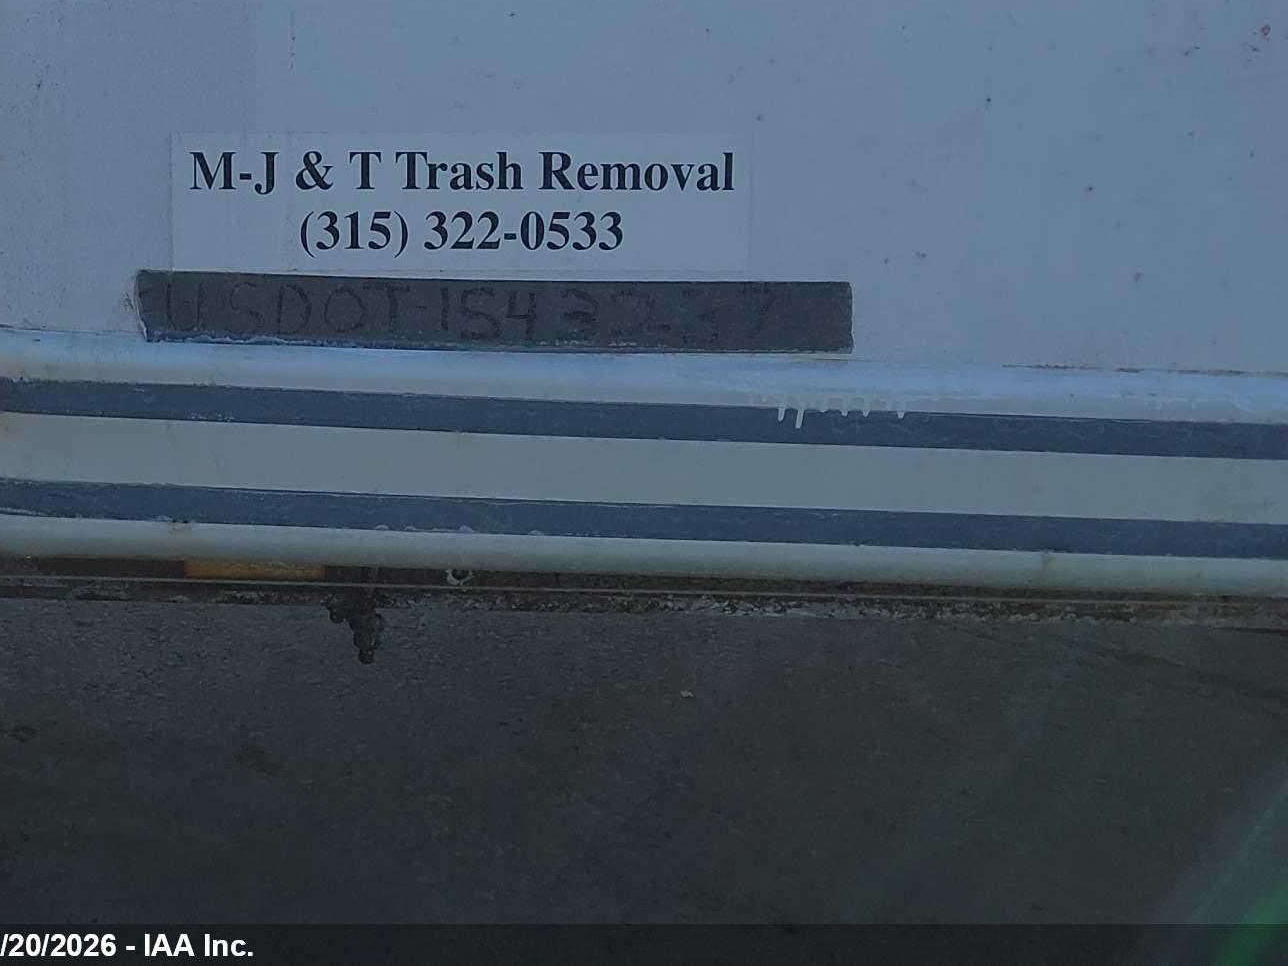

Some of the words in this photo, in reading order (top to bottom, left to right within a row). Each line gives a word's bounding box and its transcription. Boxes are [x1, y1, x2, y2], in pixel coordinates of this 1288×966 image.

[190, 151, 279, 195] M-J
[295, 150, 334, 191] &
[349, 151, 382, 190] T
[395, 151, 524, 191] Trash
[538, 151, 735, 192] Removal
[300, 210, 409, 258] (315)
[423, 210, 623, 251] 322-0533
